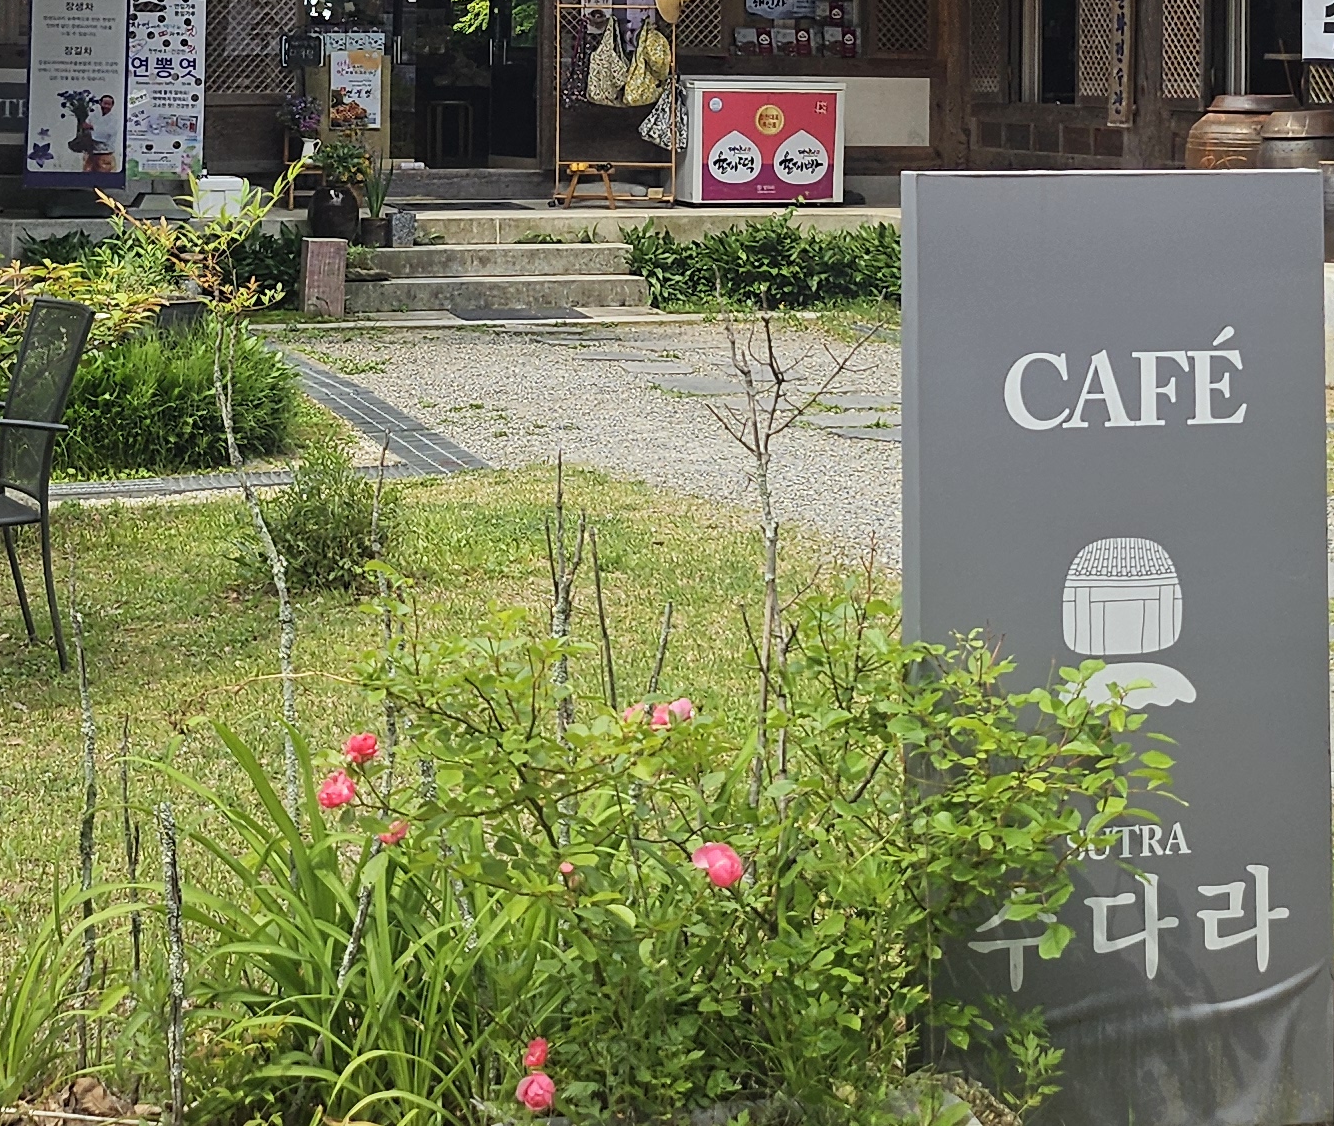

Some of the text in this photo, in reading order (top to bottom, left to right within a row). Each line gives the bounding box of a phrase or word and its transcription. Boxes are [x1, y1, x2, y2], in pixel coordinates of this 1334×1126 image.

[65, 1, 94, 12] 장생차
[753, 0, 787, 10] 해인사
[1004, 325, 1247, 430] CAFÉ
[968, 864, 1290, 992] 수다라
